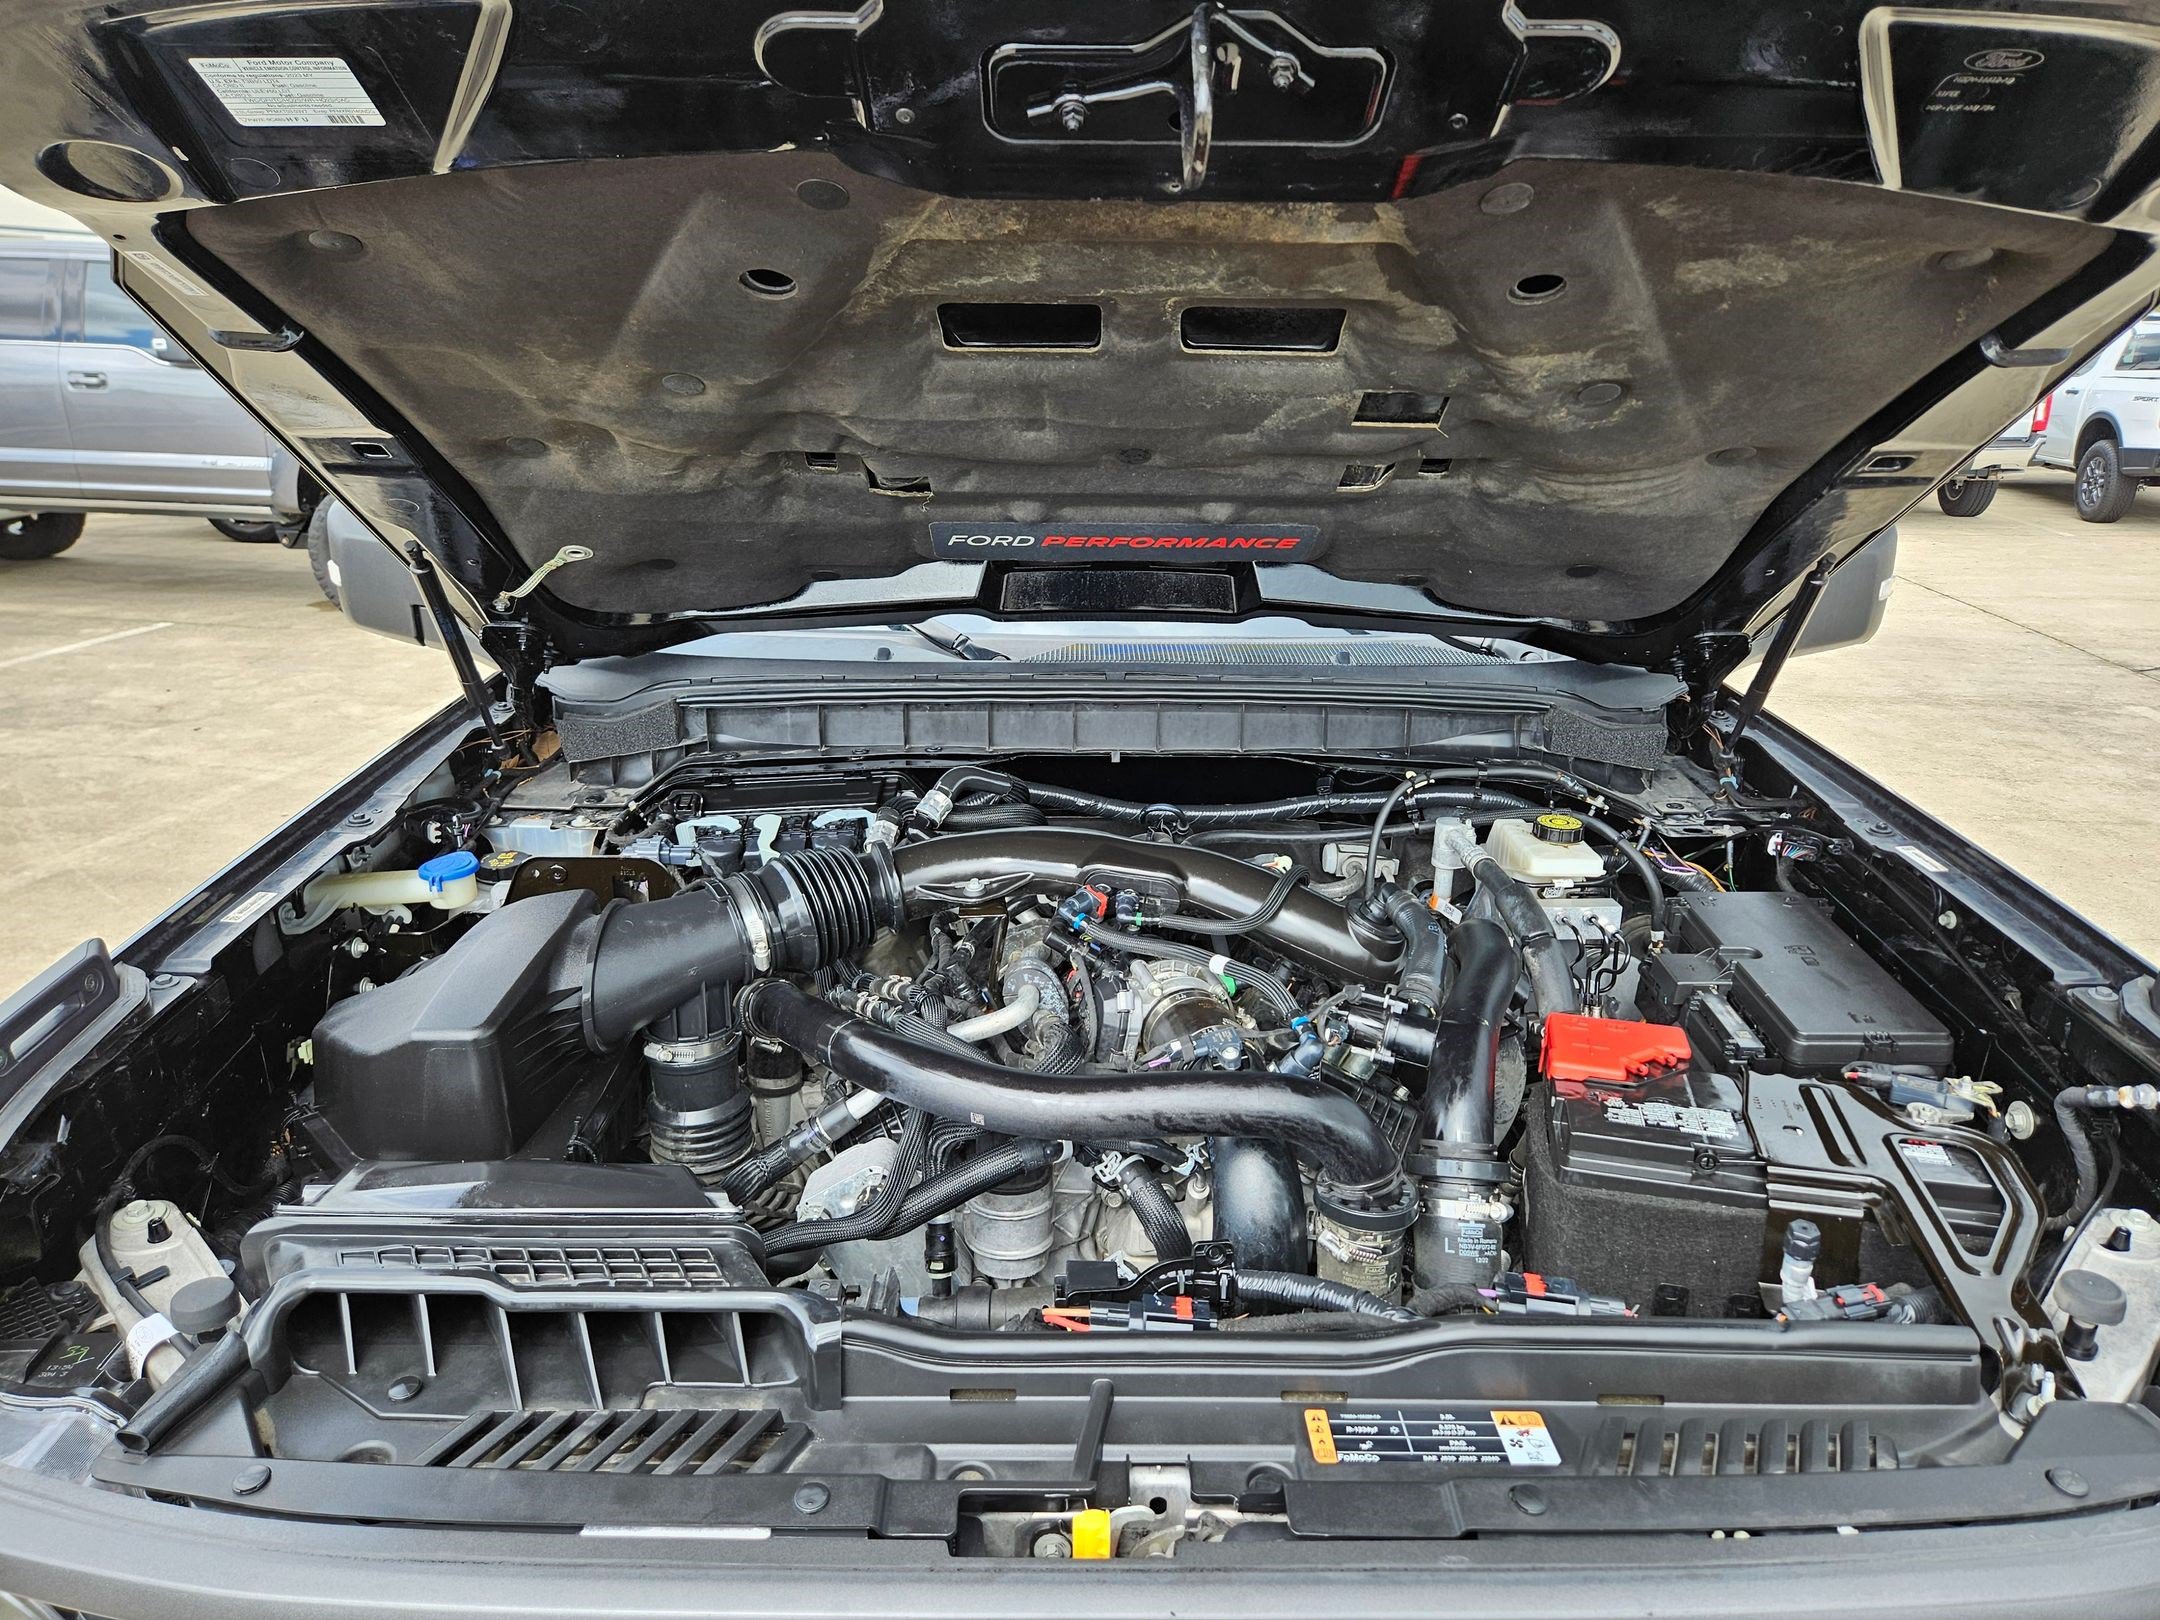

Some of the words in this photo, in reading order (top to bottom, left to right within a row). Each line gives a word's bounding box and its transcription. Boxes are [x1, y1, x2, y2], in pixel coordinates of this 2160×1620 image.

[246, 59, 267, 67] Ford
[268, 59, 293, 67] Motor
[294, 59, 334, 68] Company
[948, 535, 1036, 546] FORD
[1040, 537, 1301, 549] PERFORMANCE
[1445, 1237, 1455, 1254] L
[1388, 1272, 1398, 1288] R
[1337, 1453, 1380, 1463] FoMoCo
